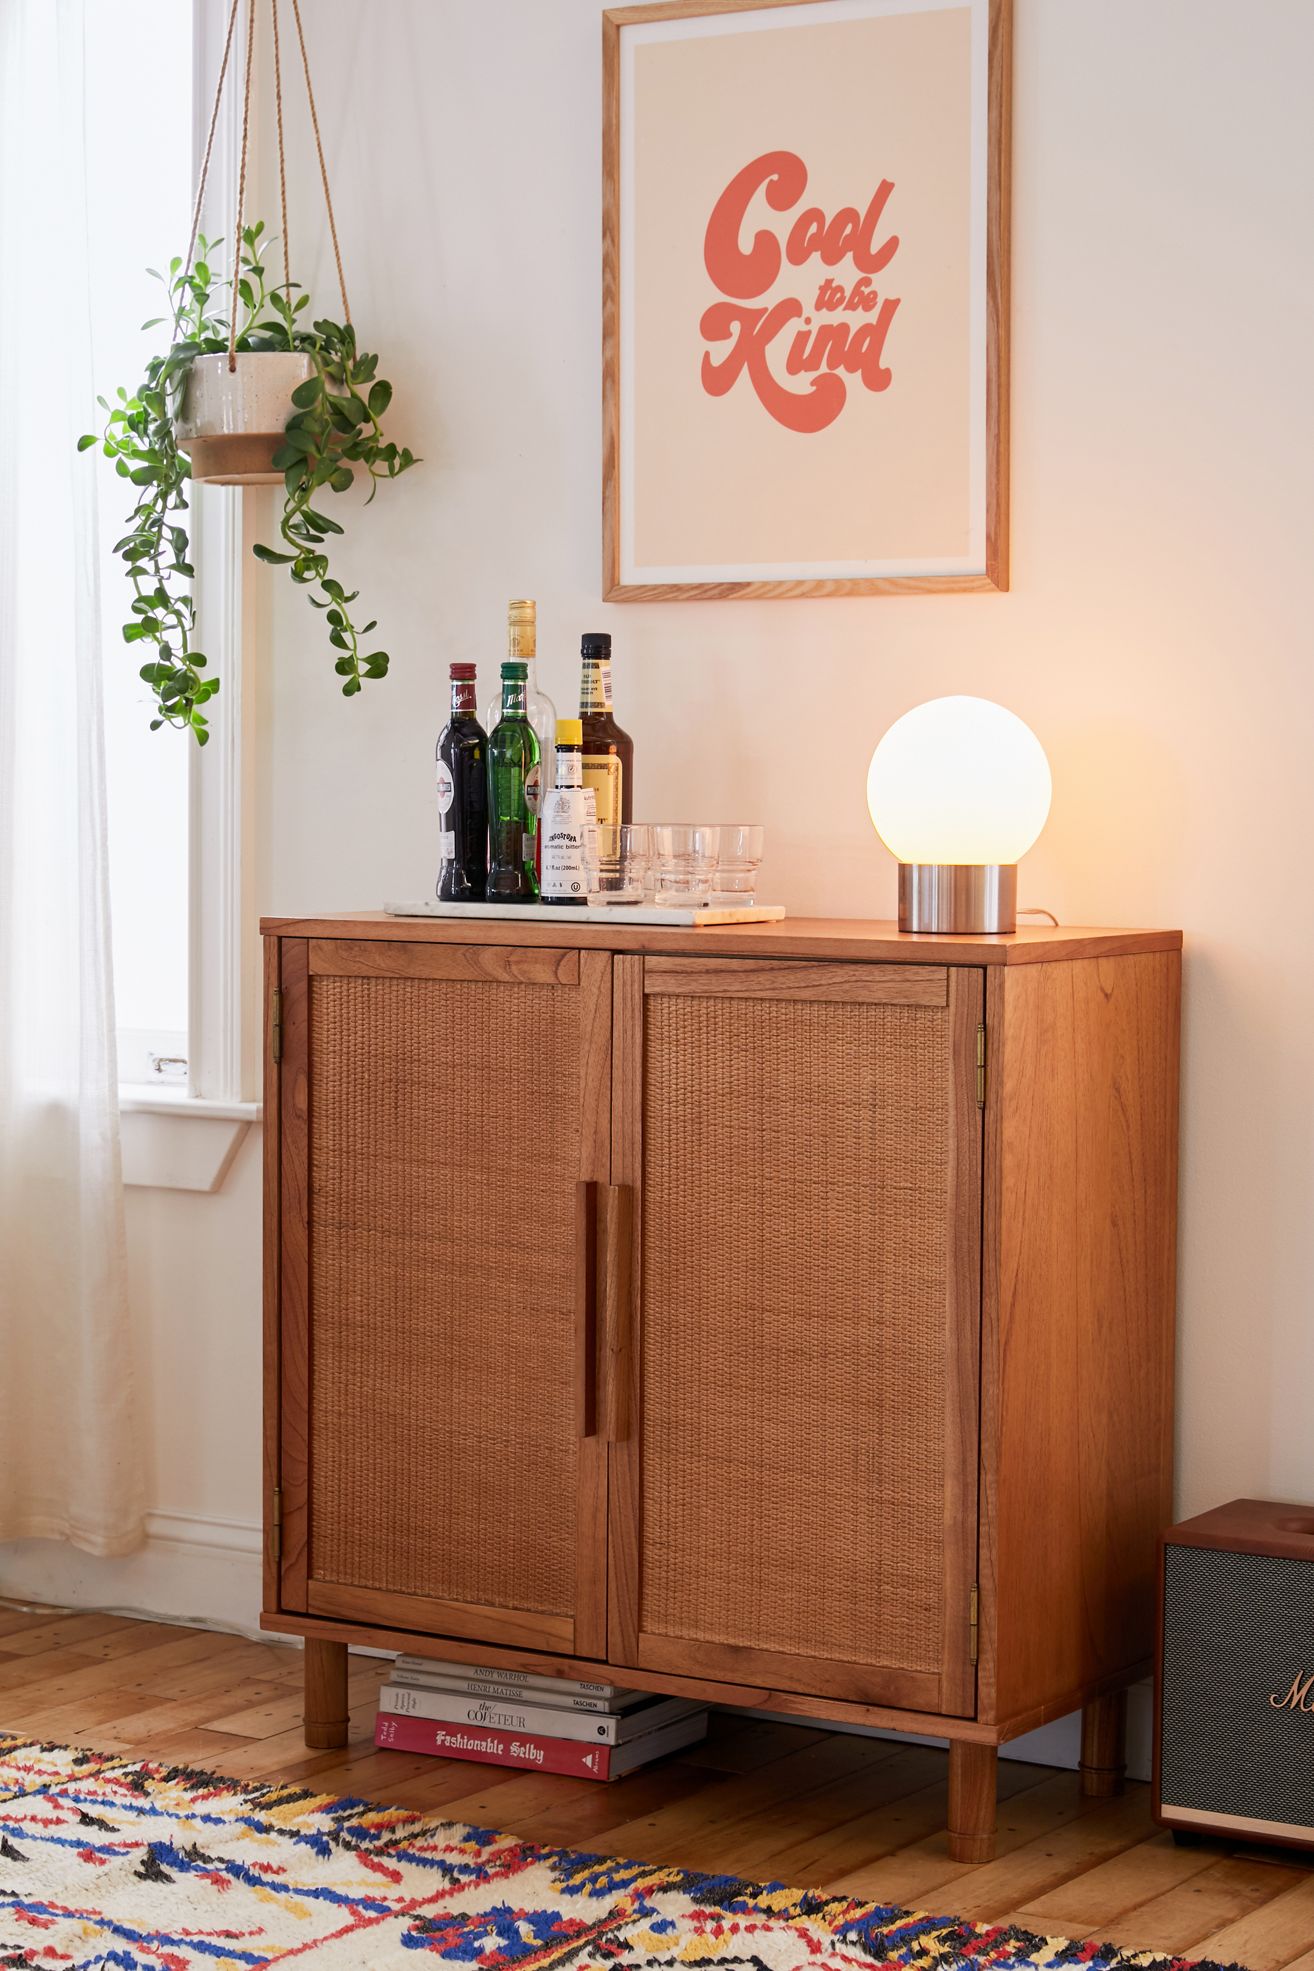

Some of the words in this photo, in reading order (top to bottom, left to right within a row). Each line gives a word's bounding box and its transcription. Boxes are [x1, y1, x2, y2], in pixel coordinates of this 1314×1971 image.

[703, 150, 900, 300] Cool
[814, 277, 846, 312] to
[842, 275, 879, 312] be
[699, 297, 902, 434] Kind
[473, 1669, 495, 1679] ANDY
[496, 1671, 528, 1682] WARHOL
[580, 1683, 605, 1692] TASCHEN
[466, 1682, 491, 1693] HENRI
[492, 1687, 523, 1698] MATISSE
[1270, 1670, 1314, 1713] M
[479, 1701, 492, 1711] the
[573, 1699, 598, 1708] TASCHEN
[435, 1730, 504, 1755] Fashionable
[510, 1741, 544, 1764] Selby
